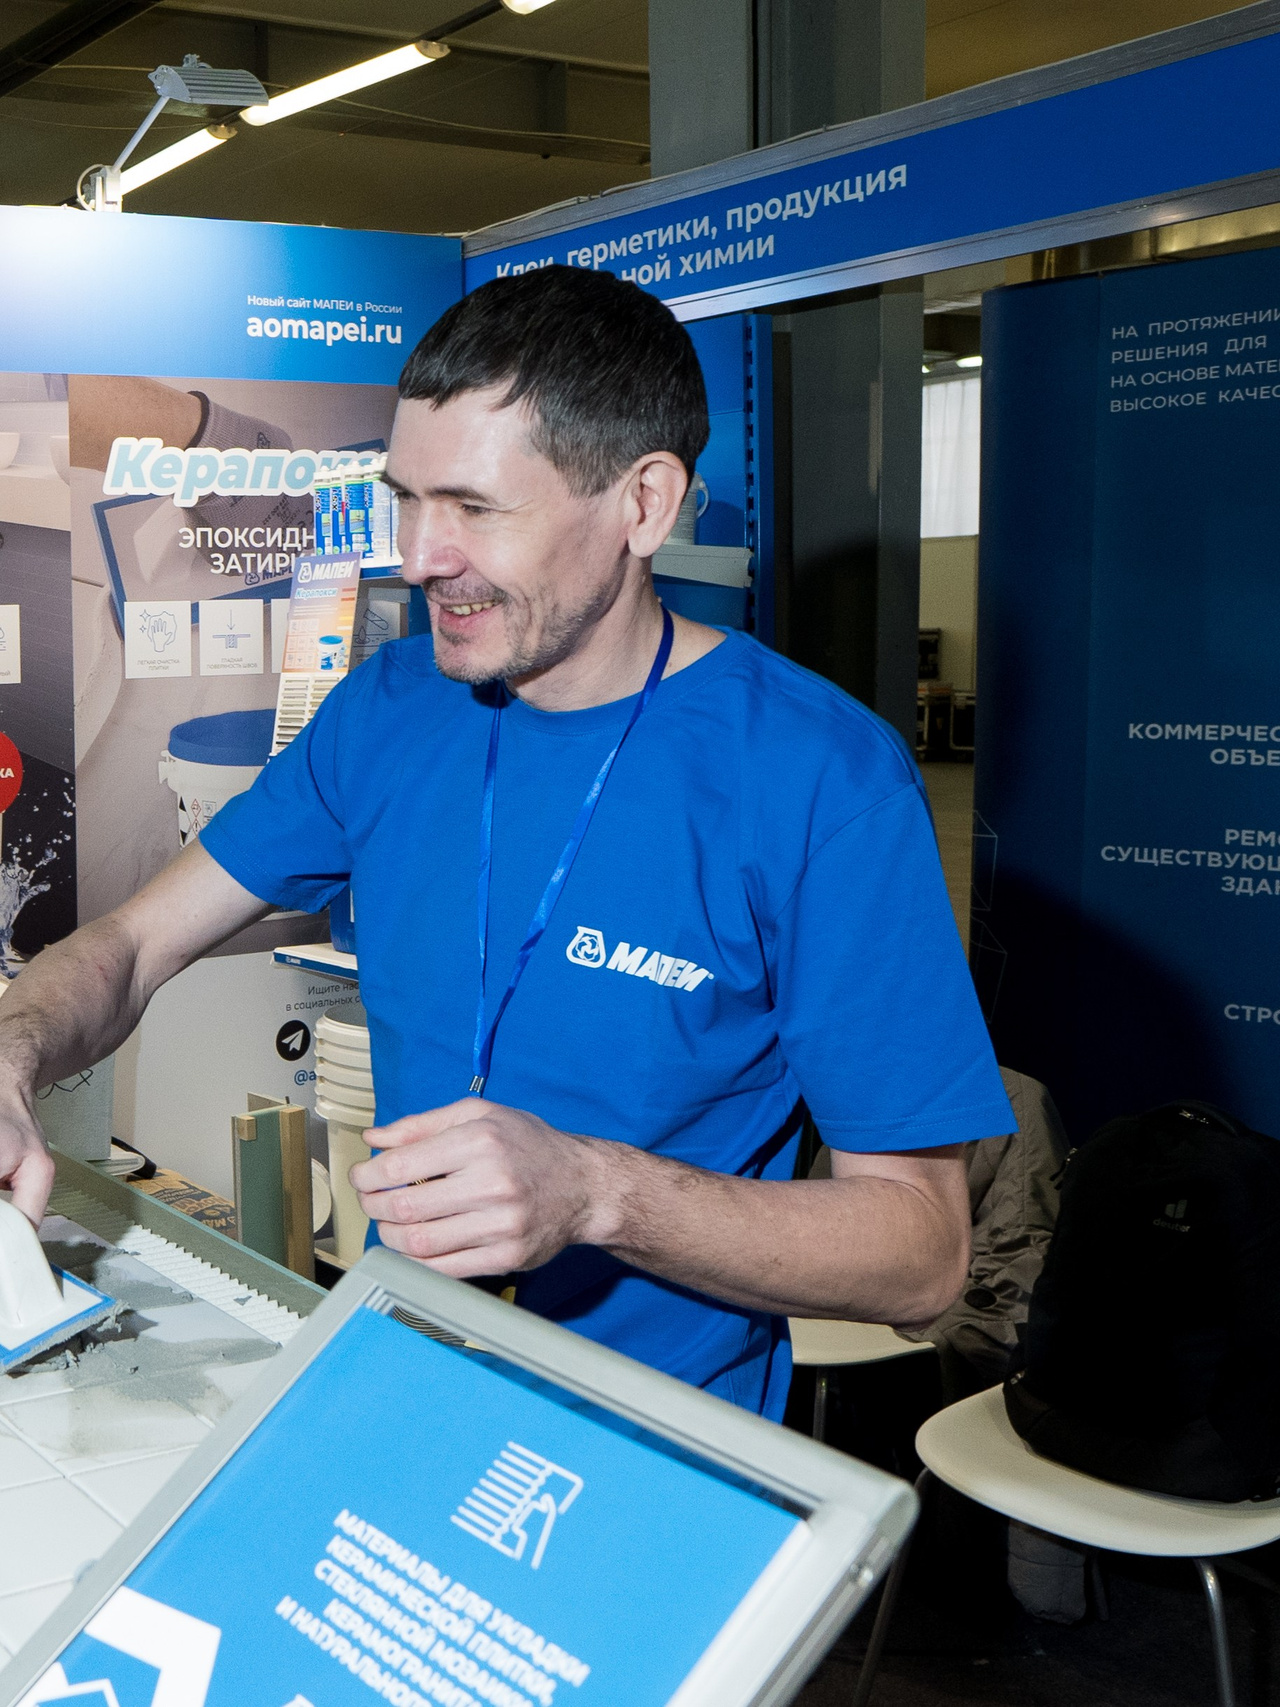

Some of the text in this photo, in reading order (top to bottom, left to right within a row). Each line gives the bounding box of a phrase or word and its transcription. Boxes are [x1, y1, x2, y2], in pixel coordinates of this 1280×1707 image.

[567, 216, 719, 270] герметики,
[726, 164, 908, 234] продукция
[621, 234, 775, 285] ной химии
[247, 294, 284, 307] Новый
[287, 297, 311, 309] сайт
[313, 299, 354, 311] МАПЕИ
[365, 302, 403, 314] России
[246, 315, 402, 347] aomapei.ru
[1112, 326, 1139, 340] НА
[1111, 335, 1267, 364] РЕШЕНИЯ ДЛЯ
[1111, 360, 1280, 388] НА ОСНОВЕ МАТЕ
[1110, 392, 1207, 413] ВЫСОКОЕ
[110, 444, 375, 500] Керапо
[312, 560, 355, 581] МАПЕИ
[295, 588, 338, 600] Керапокси
[1128, 723, 1280, 743] КОММЕРЧЕС
[1209, 748, 1280, 767] ОБЪЕ
[1225, 828, 1280, 847] РЕМ
[294, 995, 354, 1012] социальных
[308, 983, 341, 996] Ищите
[314, 1559, 437, 1654] СТЕКЛЯННОЙ
[333, 1508, 591, 1688] МАТЕРИАЛЫ ДЛЯ УКЛАДКИ
[325, 1534, 557, 1707] КЕРАМИЧЕСКОЙ ПЛИТКИ,
[275, 1595, 432, 1707] И НАТУРАЛЬНОГ
[323, 1598, 482, 1707] КЕРАМОГРАНИТ
